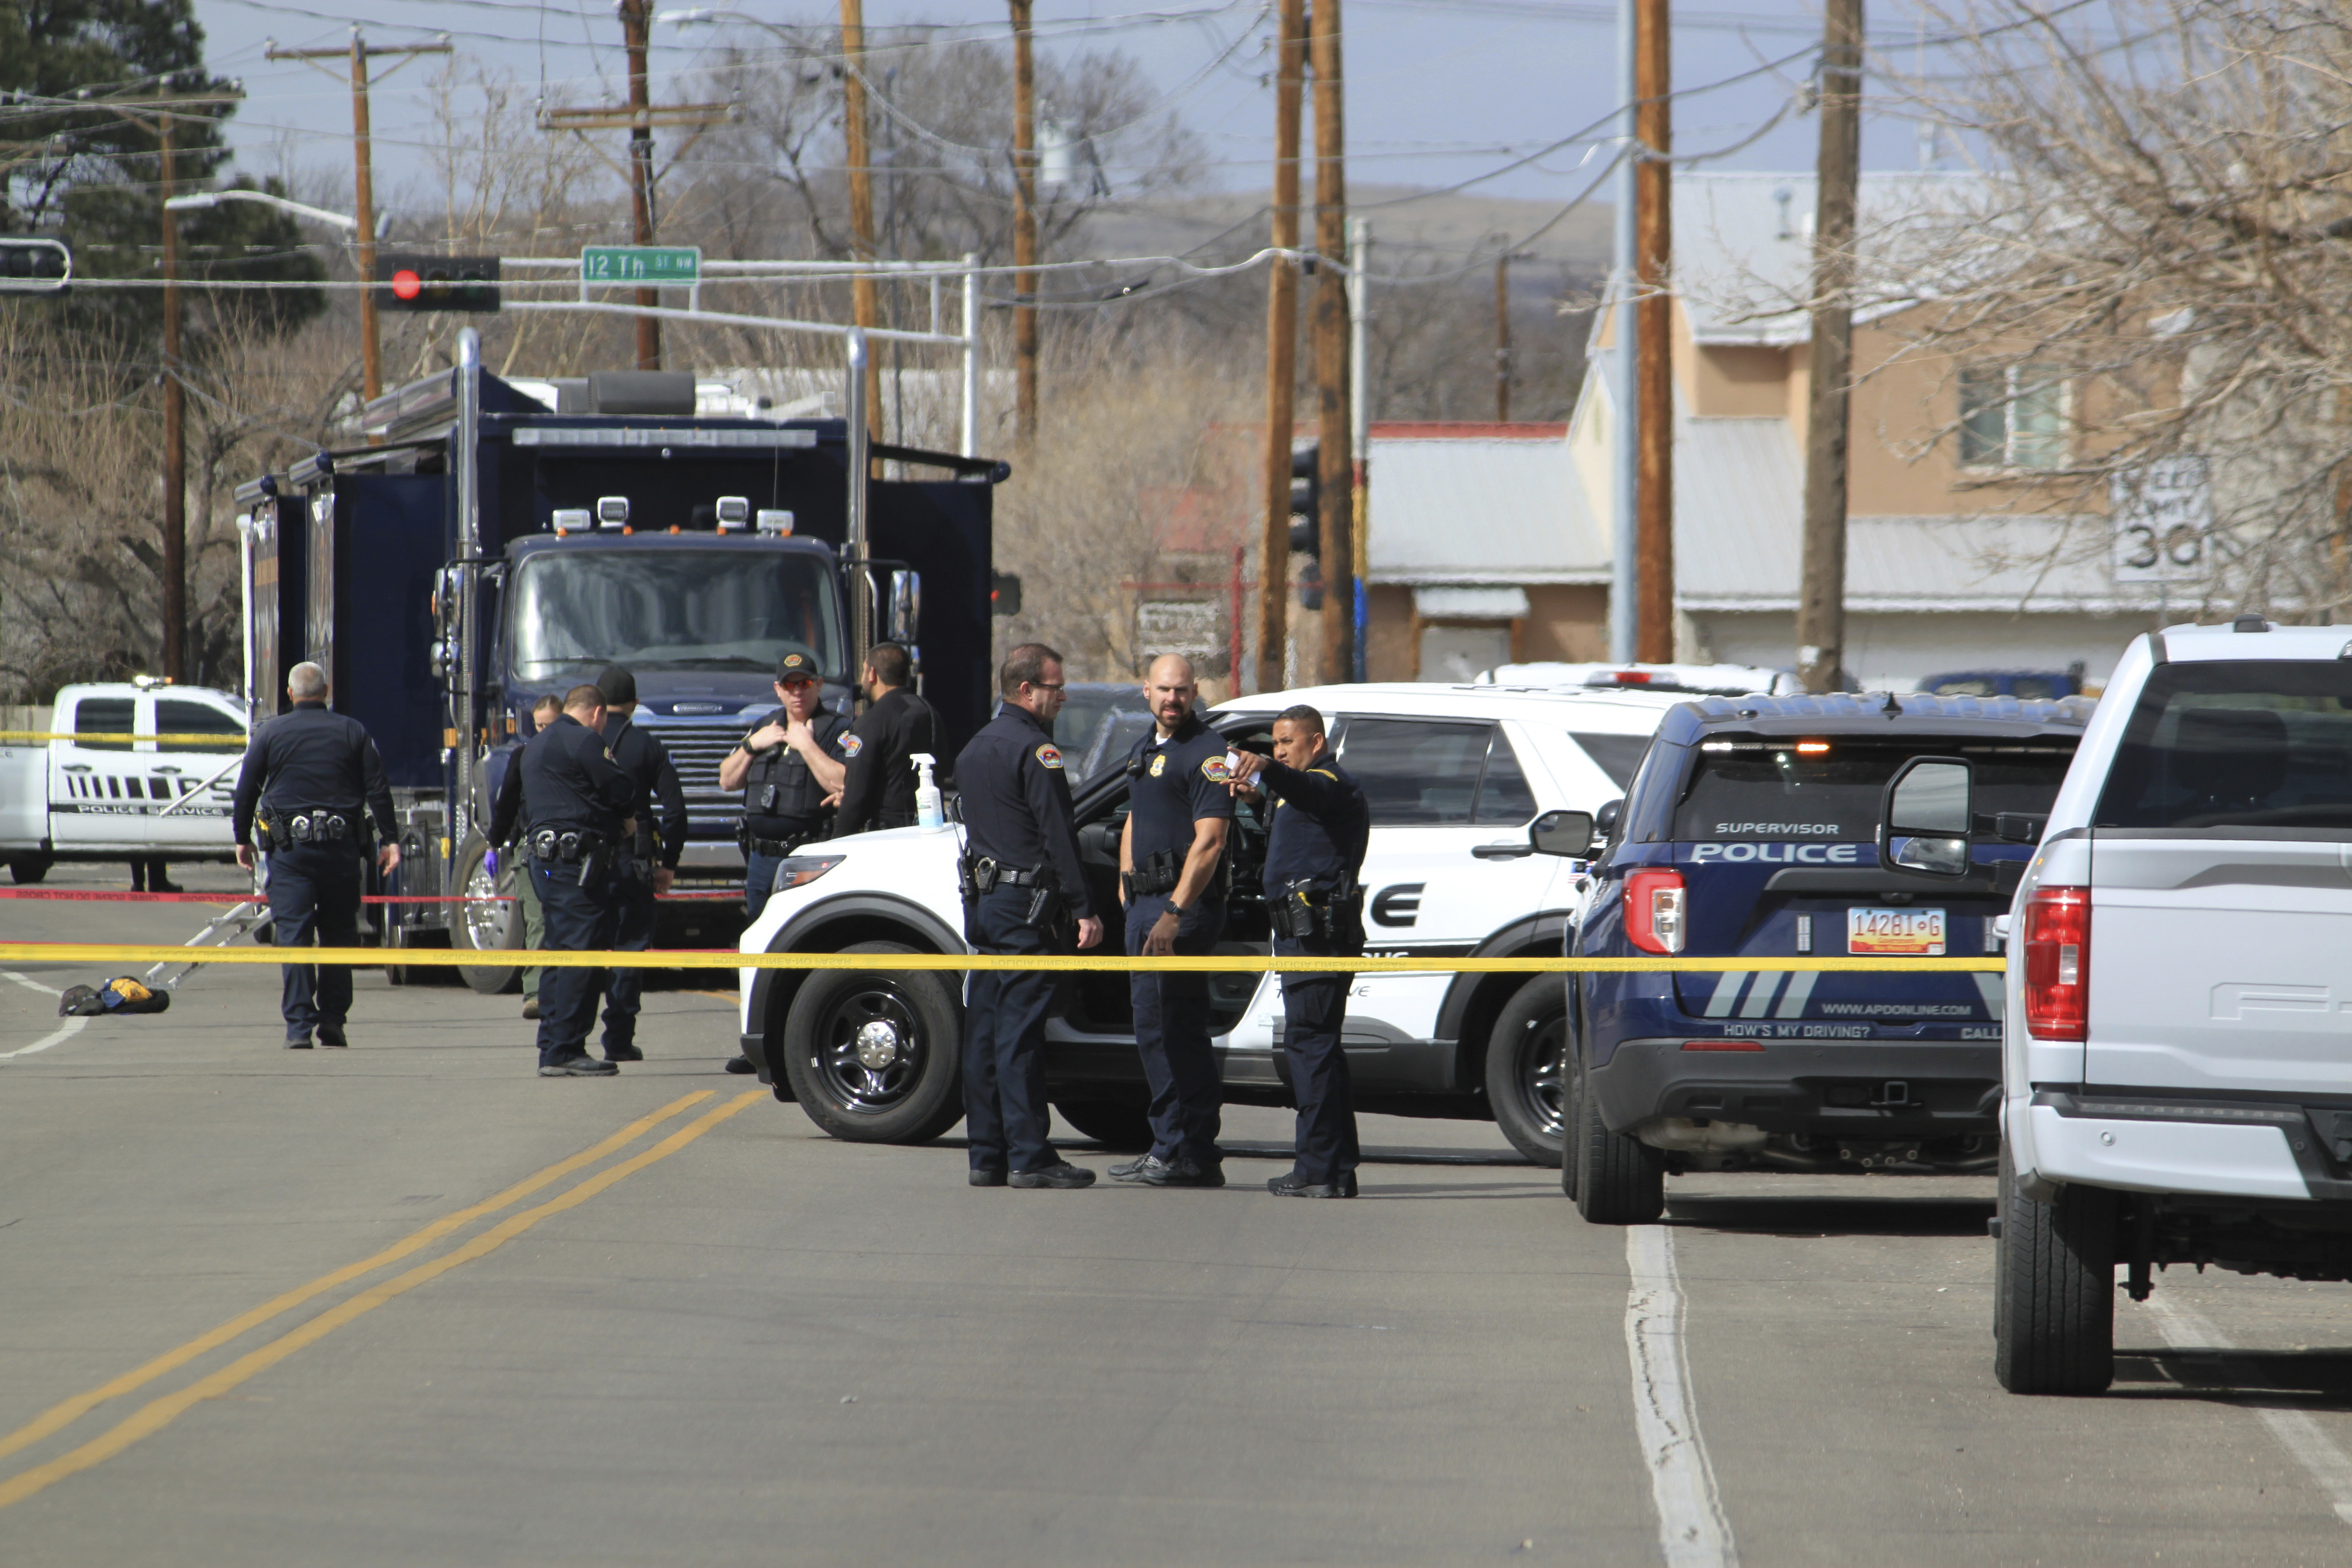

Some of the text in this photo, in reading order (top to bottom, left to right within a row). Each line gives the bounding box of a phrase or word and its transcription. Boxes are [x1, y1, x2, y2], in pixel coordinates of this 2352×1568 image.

[589, 255, 609, 277] 12
[619, 254, 644, 279] Th
[655, 254, 669, 270] ST
[2127, 524, 2201, 569] 30
[78, 804, 141, 815] POLICE
[1715, 823, 1839, 834] SUPERVISOR
[1690, 843, 1857, 863] POLICE
[1821, 1003, 1972, 1015] WWW.APDONLINE.COM
[1724, 1025, 1870, 1037] HOW'S MY DRIVING?
[1961, 1028, 2003, 1039] CALL
